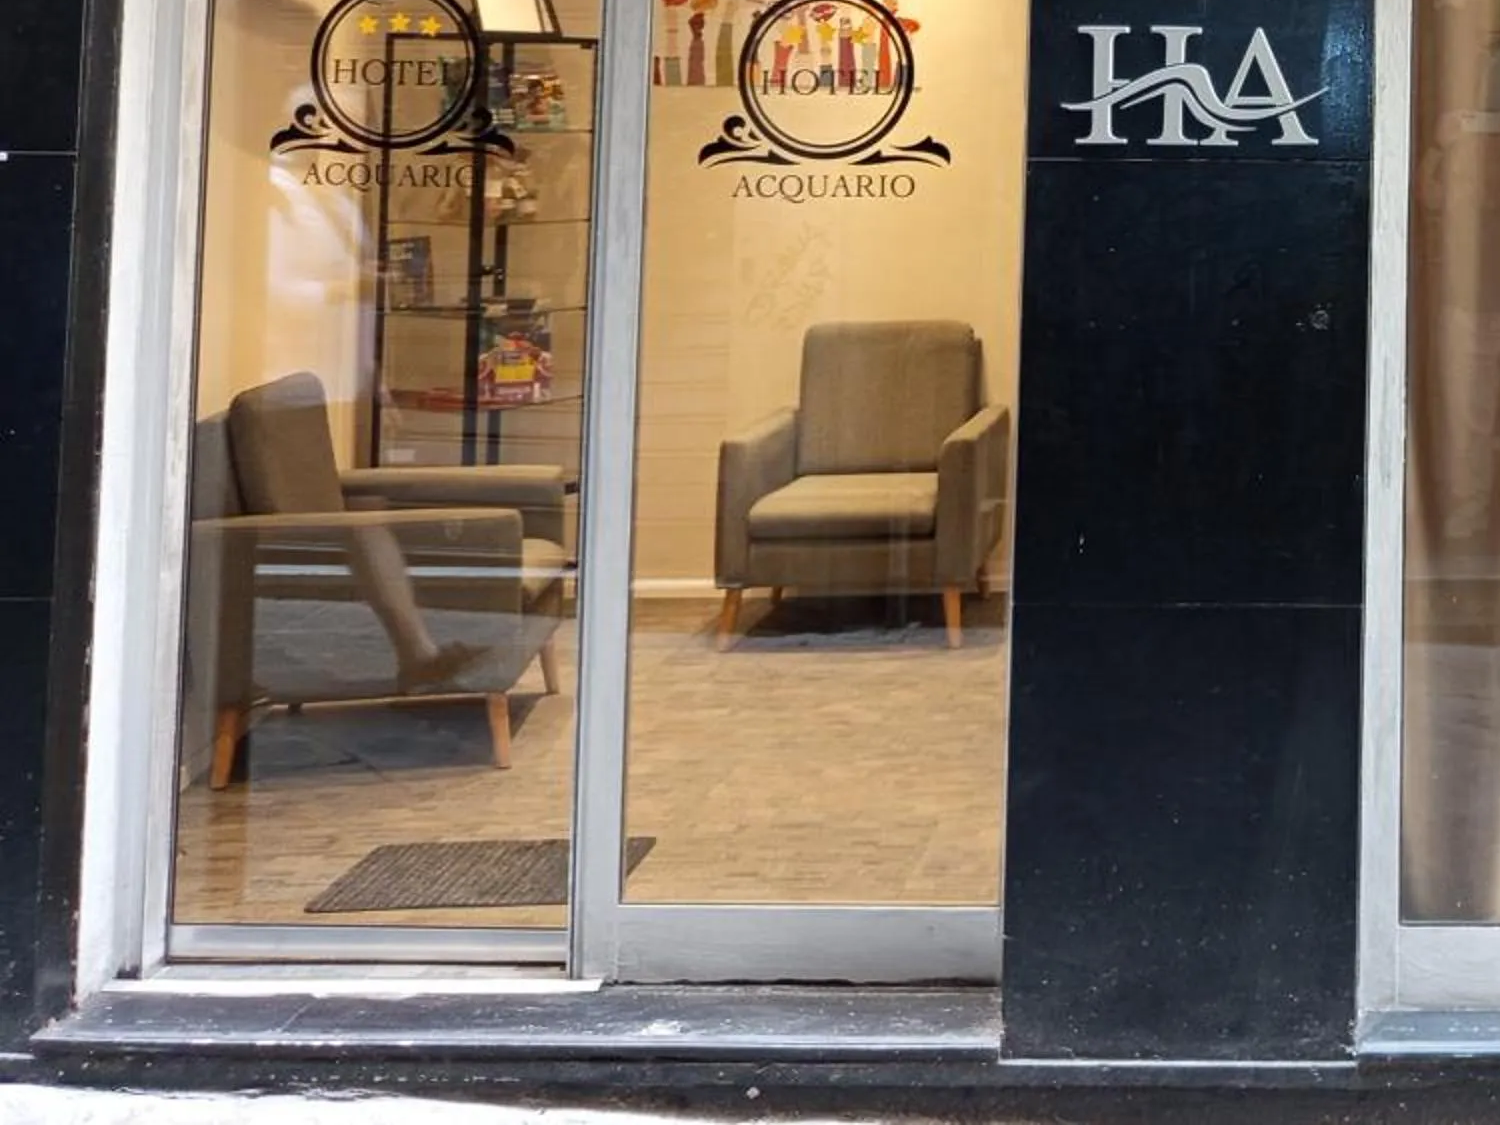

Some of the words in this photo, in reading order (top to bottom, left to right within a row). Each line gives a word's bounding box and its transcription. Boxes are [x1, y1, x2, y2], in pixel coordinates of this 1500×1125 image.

[761, 68, 894, 96] HOTEL
[1062, 25, 1330, 146] HA
[732, 174, 915, 203] ACQUARIO
